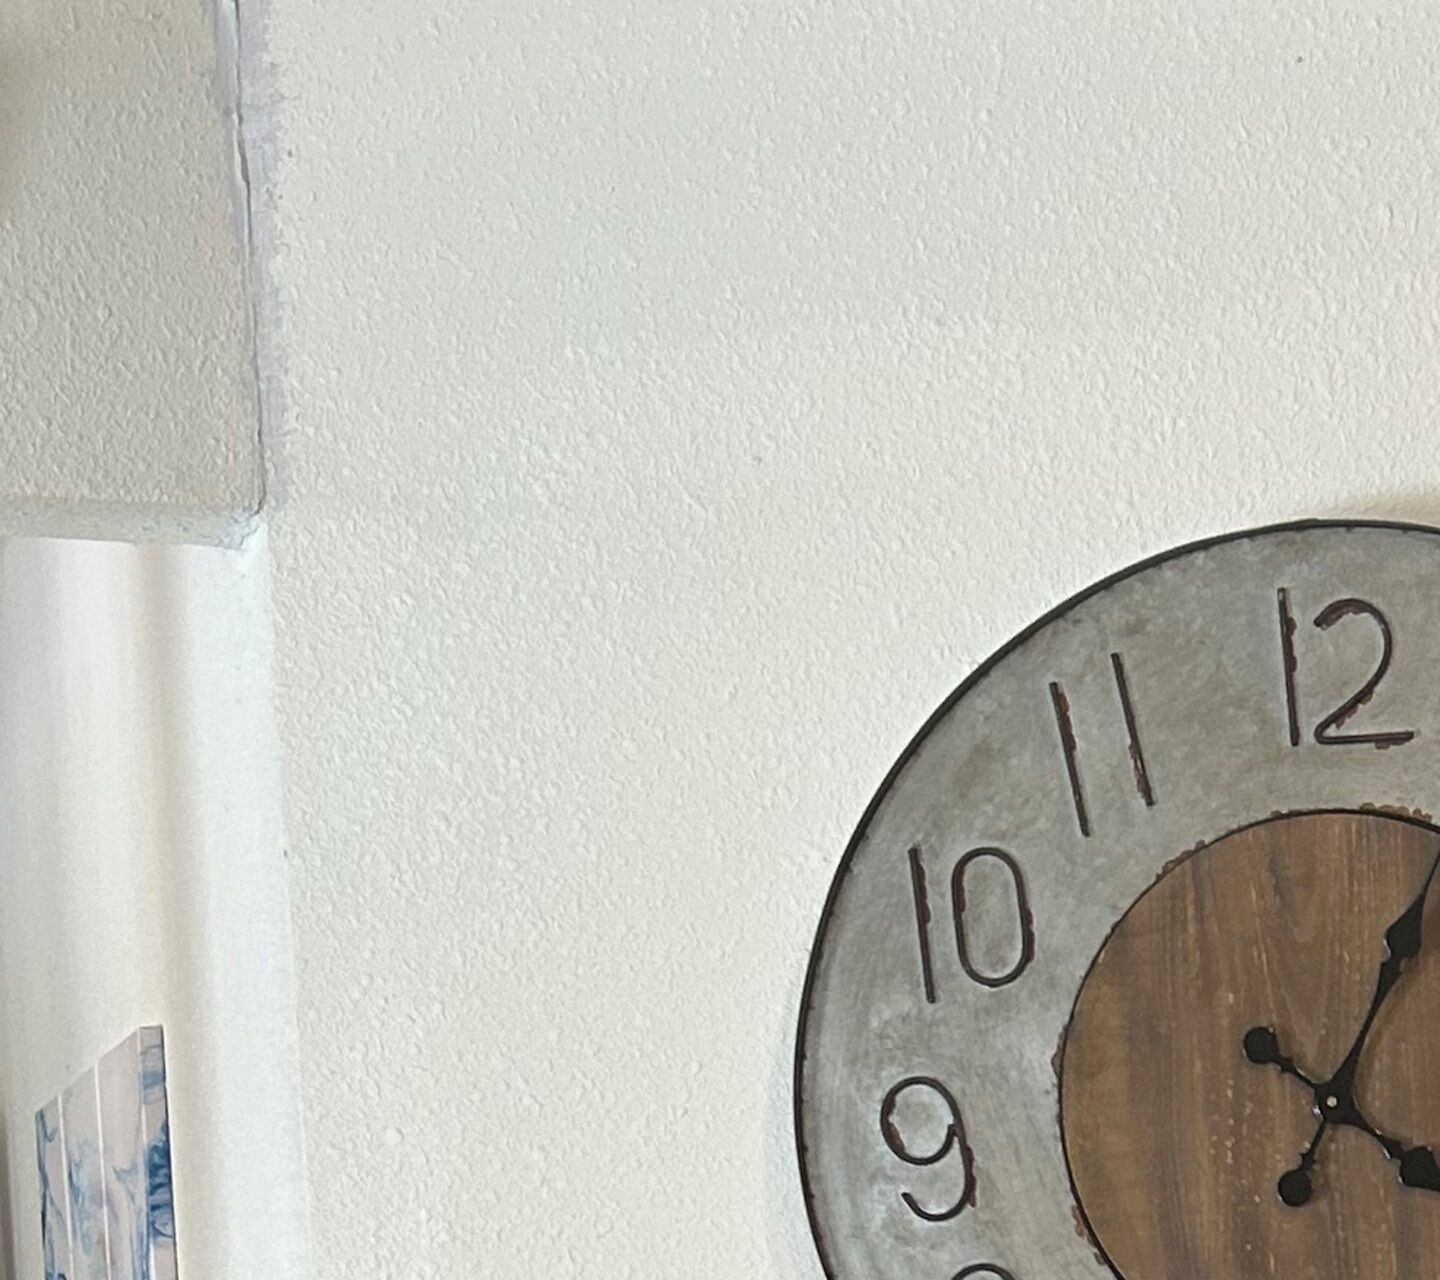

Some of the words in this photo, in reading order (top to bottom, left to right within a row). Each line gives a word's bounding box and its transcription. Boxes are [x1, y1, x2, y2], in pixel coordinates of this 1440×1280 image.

[1049, 651, 1154, 837] 11
[1277, 587, 1415, 747] 12
[908, 845, 1035, 1004] 10
[879, 1075, 978, 1222] 9
